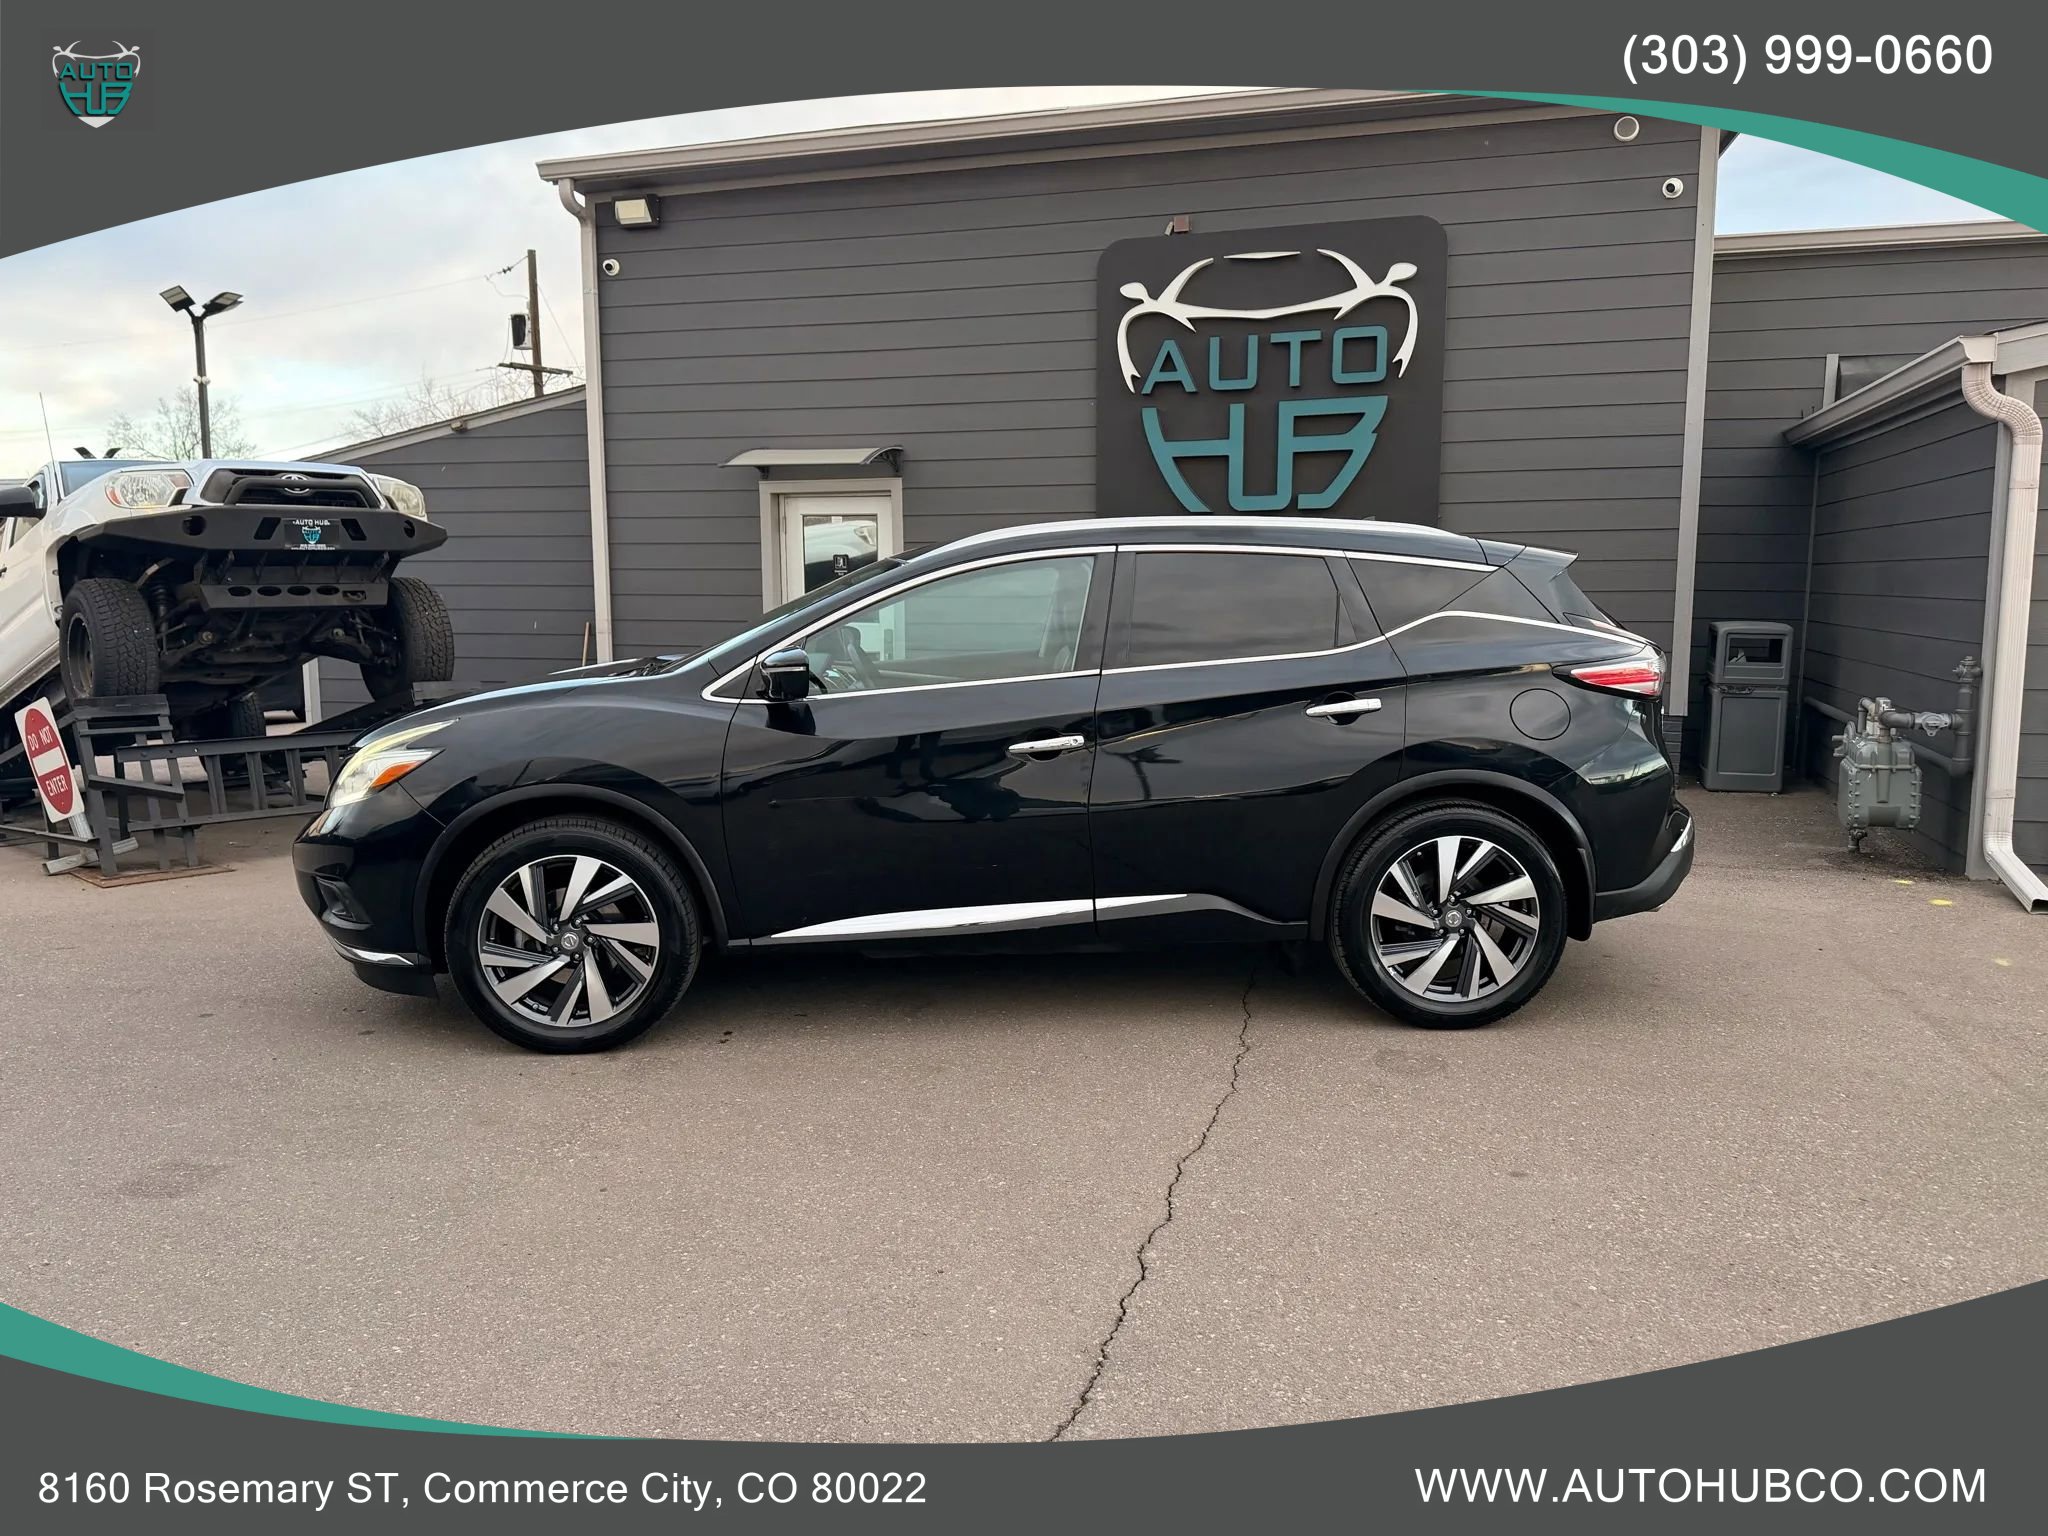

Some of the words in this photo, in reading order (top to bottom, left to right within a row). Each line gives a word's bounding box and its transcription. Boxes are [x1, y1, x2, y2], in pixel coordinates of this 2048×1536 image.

[1140, 325, 1388, 396] AUTO
[1141, 395, 1389, 513] HUB
[27, 734, 39, 750] DO
[39, 726, 53, 745] NOT
[46, 775, 68, 796] ENTER
